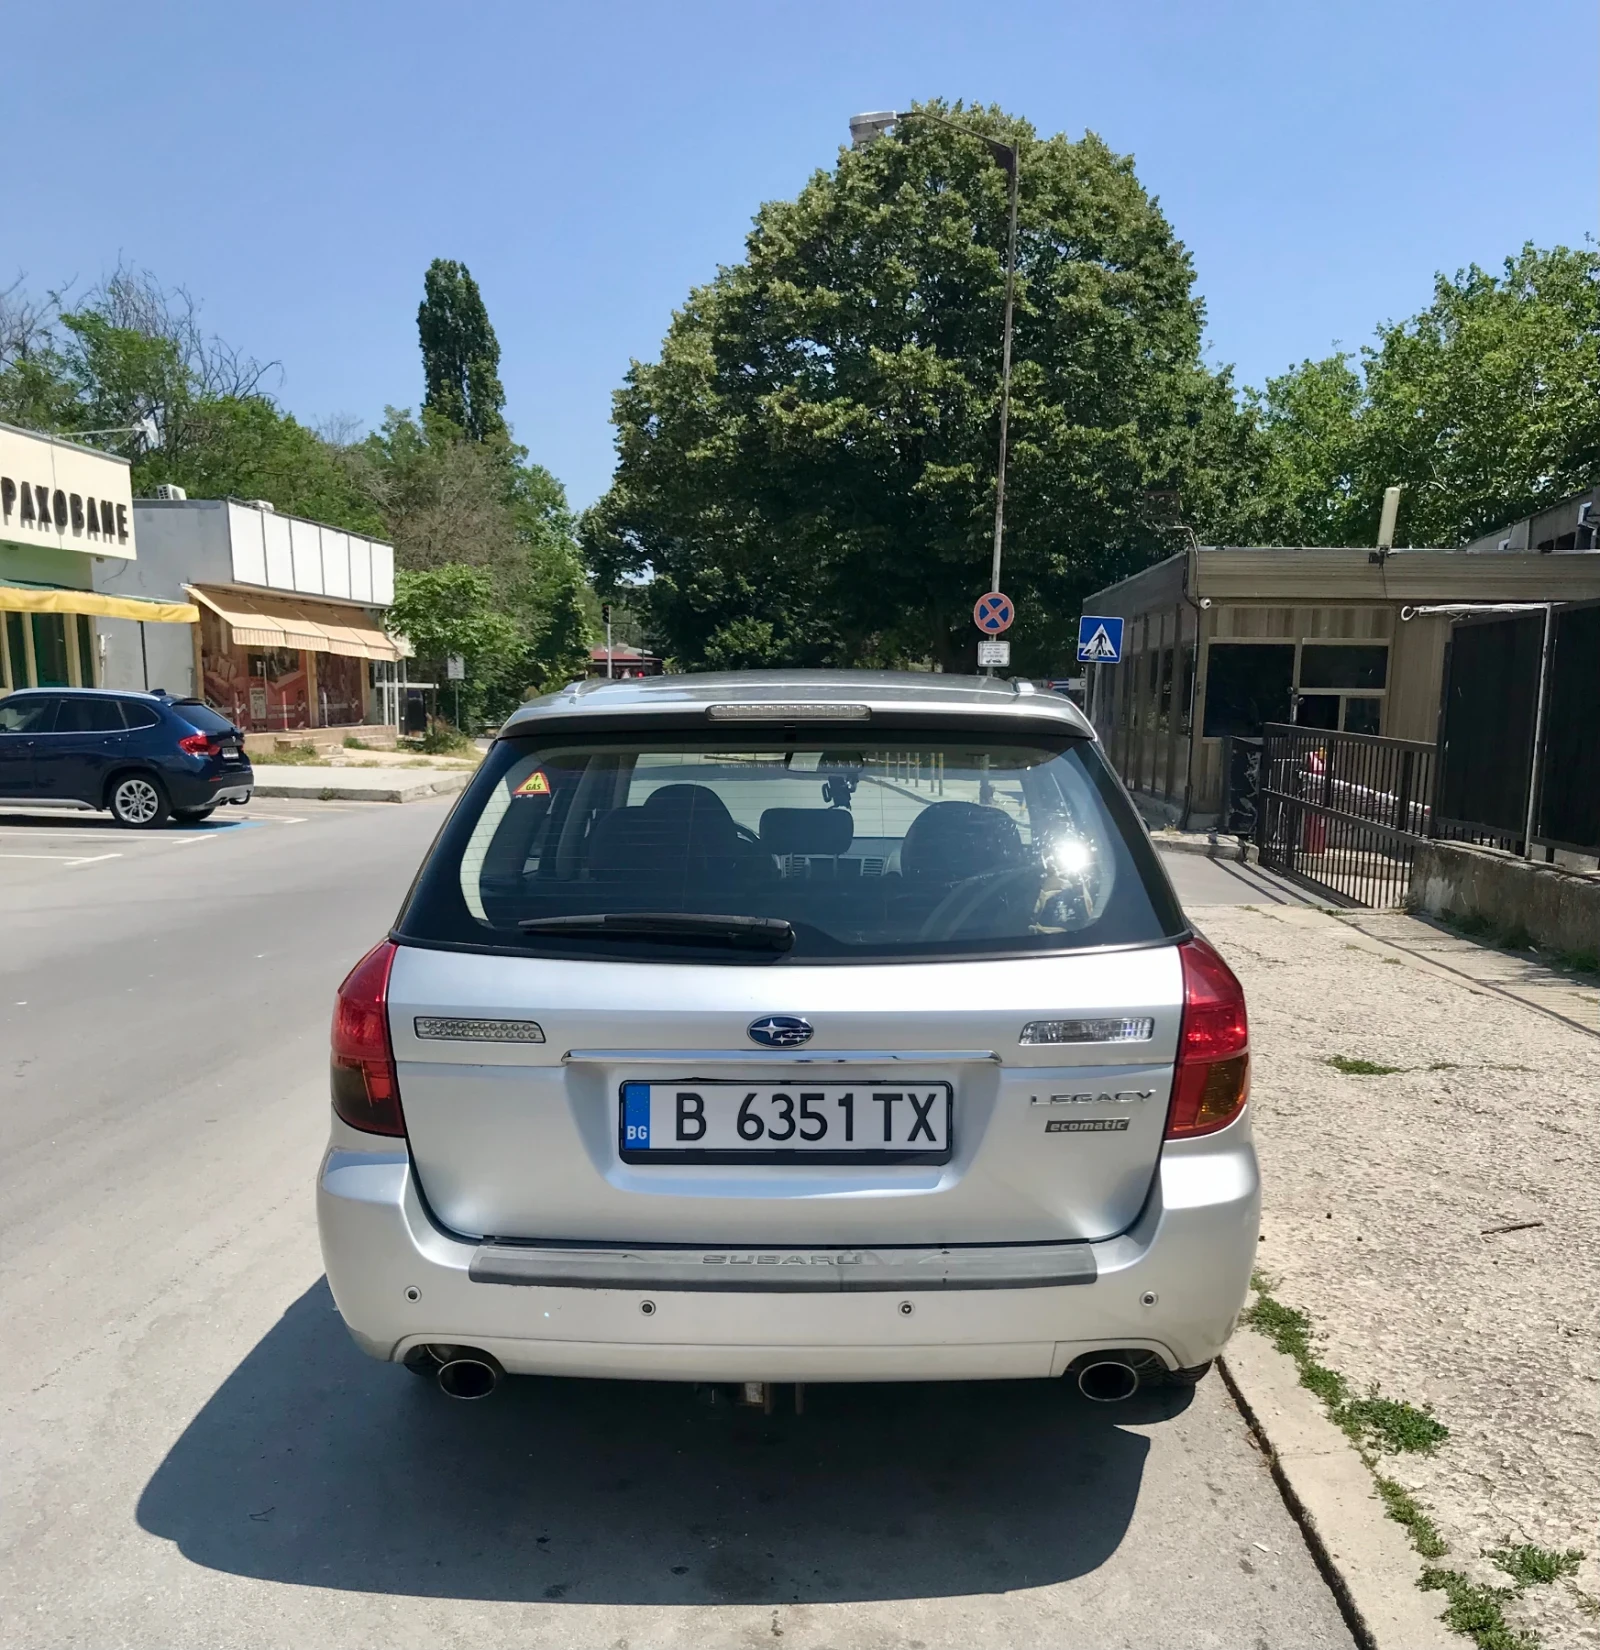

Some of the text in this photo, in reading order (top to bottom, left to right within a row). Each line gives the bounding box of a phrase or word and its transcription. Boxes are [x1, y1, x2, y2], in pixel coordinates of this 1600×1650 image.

[525, 783, 542, 791] GAS
[1030, 1089, 1157, 1106] LEGACY
[626, 1092, 937, 1142] BG B 6351 TX
[1049, 1119, 1126, 1132] ecomatic
[702, 1254, 863, 1265] SUBARU
